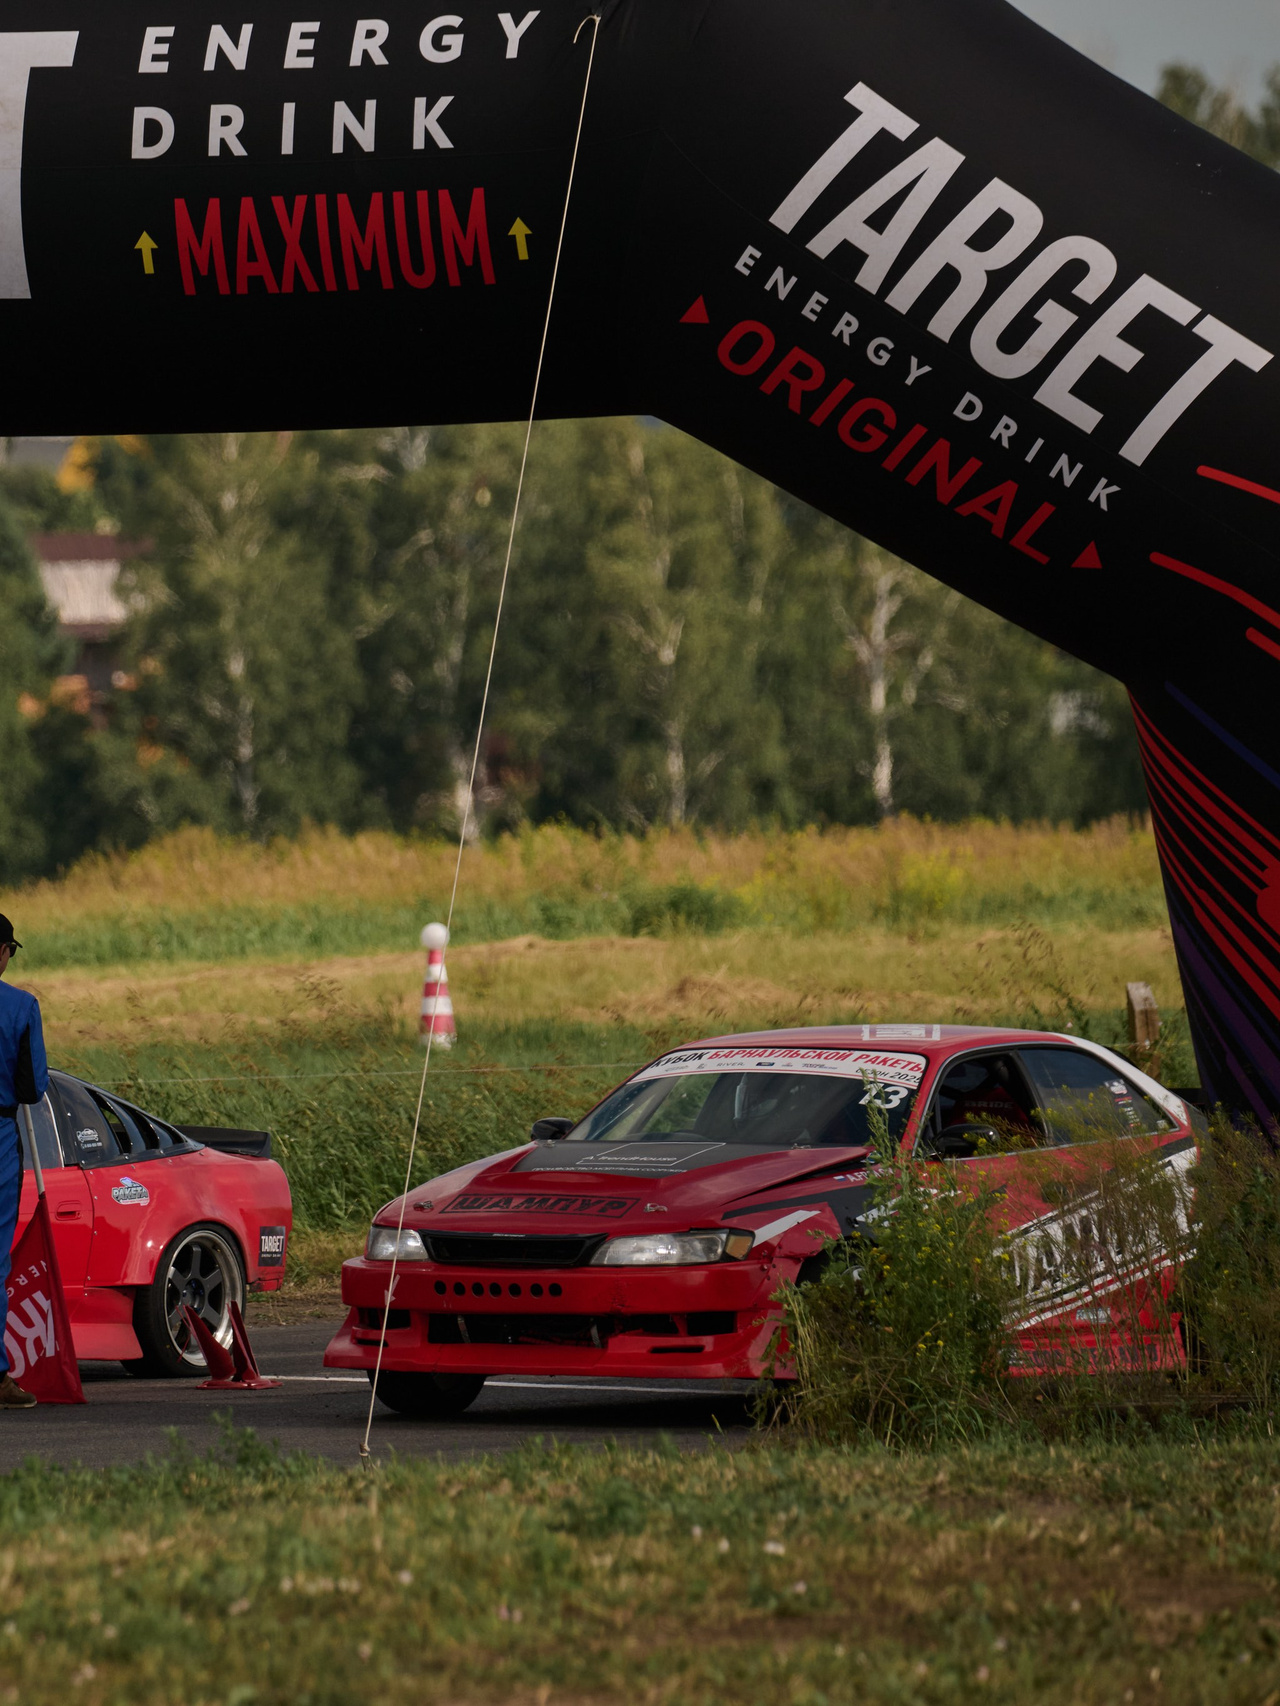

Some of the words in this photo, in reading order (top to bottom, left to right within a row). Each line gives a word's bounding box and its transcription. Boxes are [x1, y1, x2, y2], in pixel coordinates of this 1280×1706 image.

[138, 10, 541, 73] ENERGY
[131, 96, 455, 160] DRINK
[174, 187, 496, 296] MAXIMUM
[768, 81, 1275, 467] TARGET
[734, 245, 932, 387] ENERGY
[953, 391, 1121, 512] DRINK
[717, 319, 1056, 566] ORIGINAL
[651, 1051, 710, 1068] КУБОК
[707, 1049, 854, 1061] БАРНАУЛЬСКОЙ
[451, 1196, 627, 1213] ШАМПУР
[261, 1235, 284, 1252] TARGET
